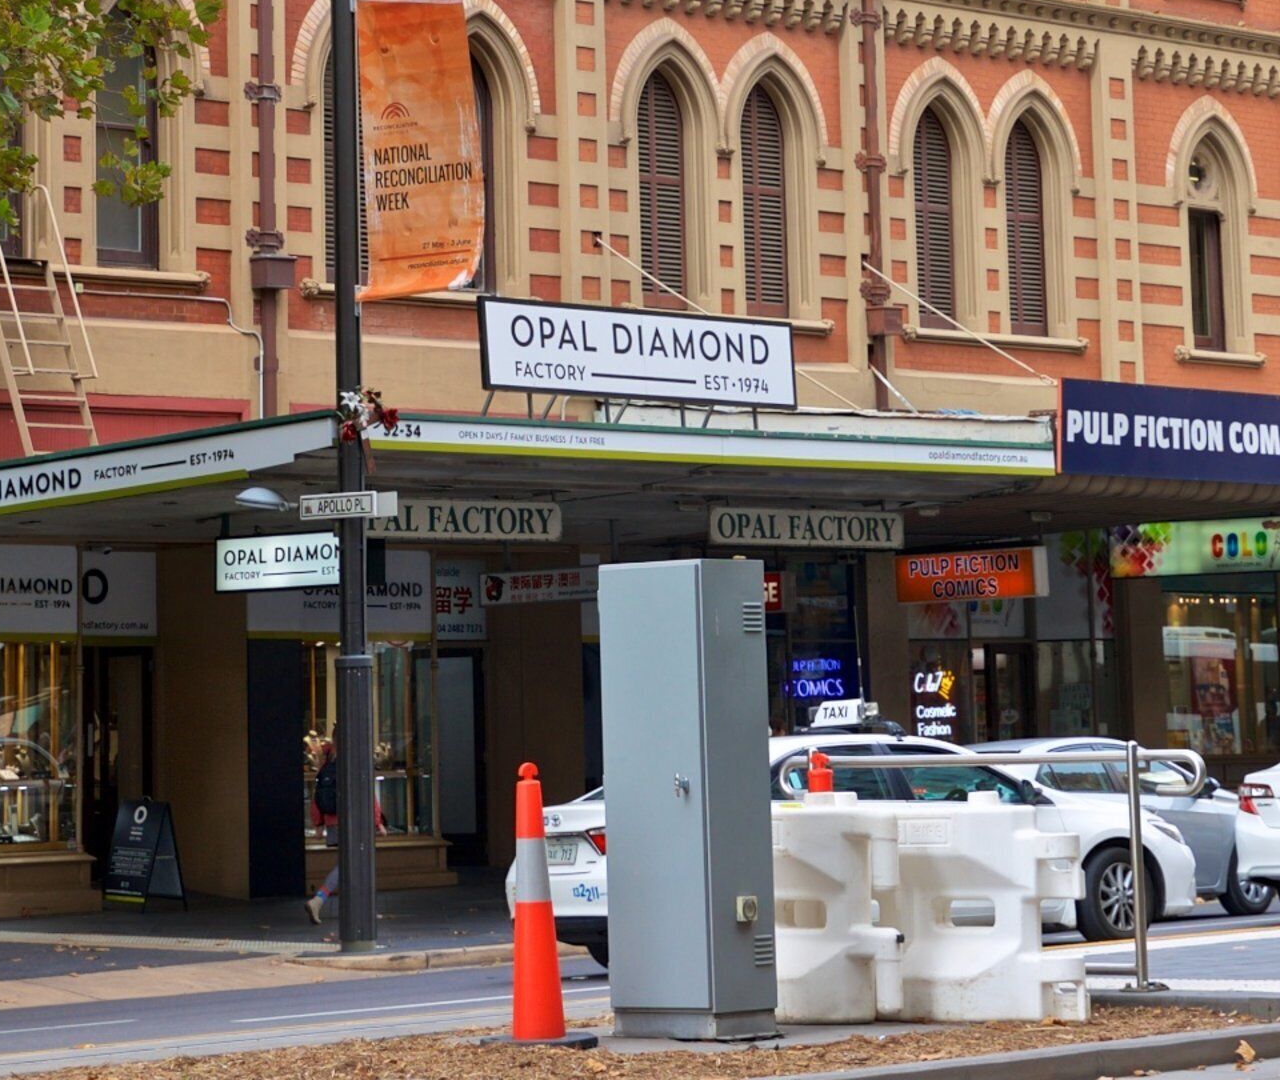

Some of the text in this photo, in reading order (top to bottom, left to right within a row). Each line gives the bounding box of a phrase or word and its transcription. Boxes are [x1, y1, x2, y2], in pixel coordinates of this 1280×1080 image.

[374, 142, 432, 166] NATIONAL
[375, 161, 473, 189] RECONCILIATION
[375, 191, 410, 212] WEEK
[510, 314, 770, 365] OPAL DIAMOND
[514, 361, 586, 381] FACTORY
[383, 422, 421, 437] 32-34
[458, 430, 479, 440] OPEN
[485, 431, 504, 441] DAYS
[509, 433, 534, 443] FAMILY
[535, 434, 566, 444] BUSINESS
[574, 436, 588, 445] TAX
[588, 437, 605, 446] FREE
[1066, 409, 1129, 446] PULP
[1134, 414, 1224, 452] FICTION
[928, 450, 1029, 464] opaldiamondfactory.com.au
[93, 464, 139, 481] FACTORY
[317, 498, 365, 513] APOLLO PL
[367, 505, 554, 535] AL FACTORY
[717, 512, 897, 542] OPAL FACTORY
[223, 548, 267, 566] OPAL
[908, 553, 1019, 578] PULP FICTION
[224, 571, 261, 581] FACTORY
[932, 578, 998, 599] COMICS
[303, 601, 337, 610] FACTORY
[436, 586, 473, 615] 留学
[447, 623, 465, 633] 2482
[823, 705, 849, 719] TAXI
[916, 703, 957, 719] Cosmetic
[917, 722, 952, 737] Fashion
